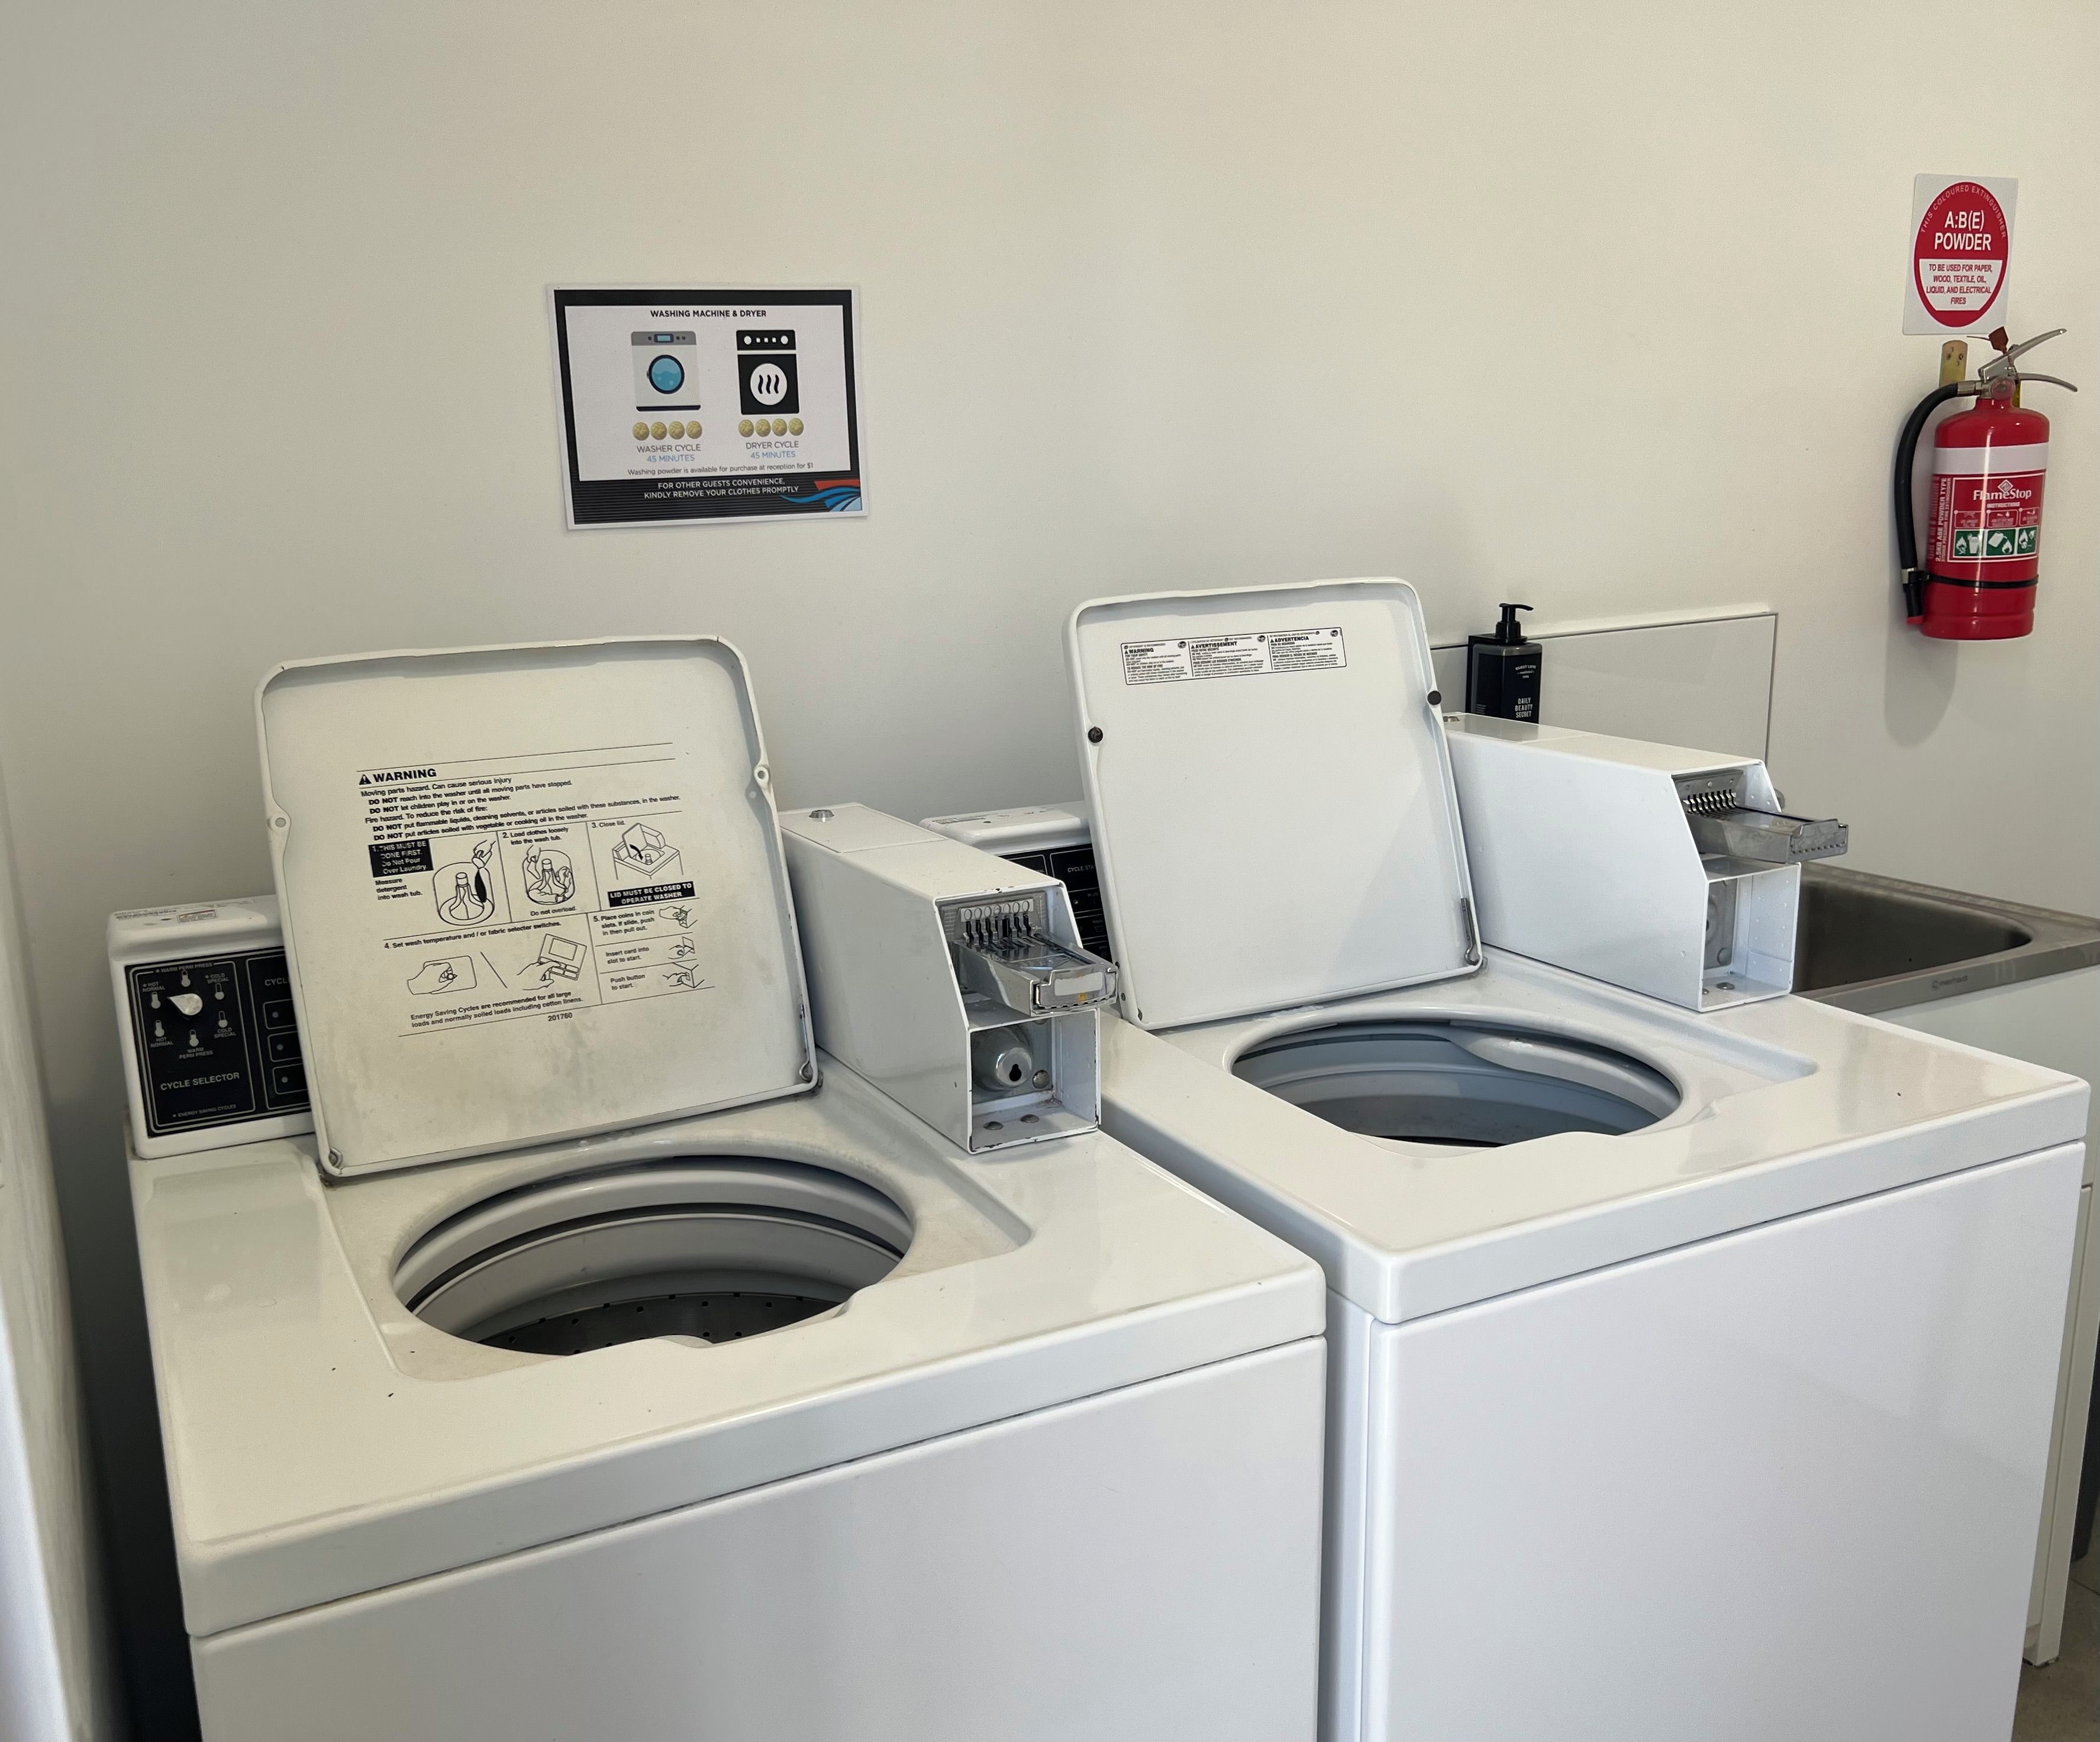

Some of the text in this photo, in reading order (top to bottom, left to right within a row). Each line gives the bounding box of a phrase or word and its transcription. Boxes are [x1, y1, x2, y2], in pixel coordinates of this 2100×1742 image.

[1920, 185, 2006, 238] THIS COLOURED EXTINGUISHER
[1944, 210, 1984, 231] A:B(E)
[1934, 233, 1991, 251] POWDER
[1974, 264, 1992, 273] PAPER,
[1933, 275, 1986, 284] WOOD, TEXTILE, OIL,
[1926, 286, 1945, 294] LIQUID,
[732, 478, 785, 486] CONVENIENCE,
[762, 486, 799, 494] PROMPTLY
[1973, 488, 2031, 500] FlameStop
[373, 769, 437, 783] WARNING
[654, 884, 681, 892] CLOSED
[621, 892, 682, 904] OPERATE WASHER
[264, 978, 289, 986] CYCL
[548, 1012, 573, 1022] 201760
[160, 1072, 240, 1091] CYCLE SELECTOR
